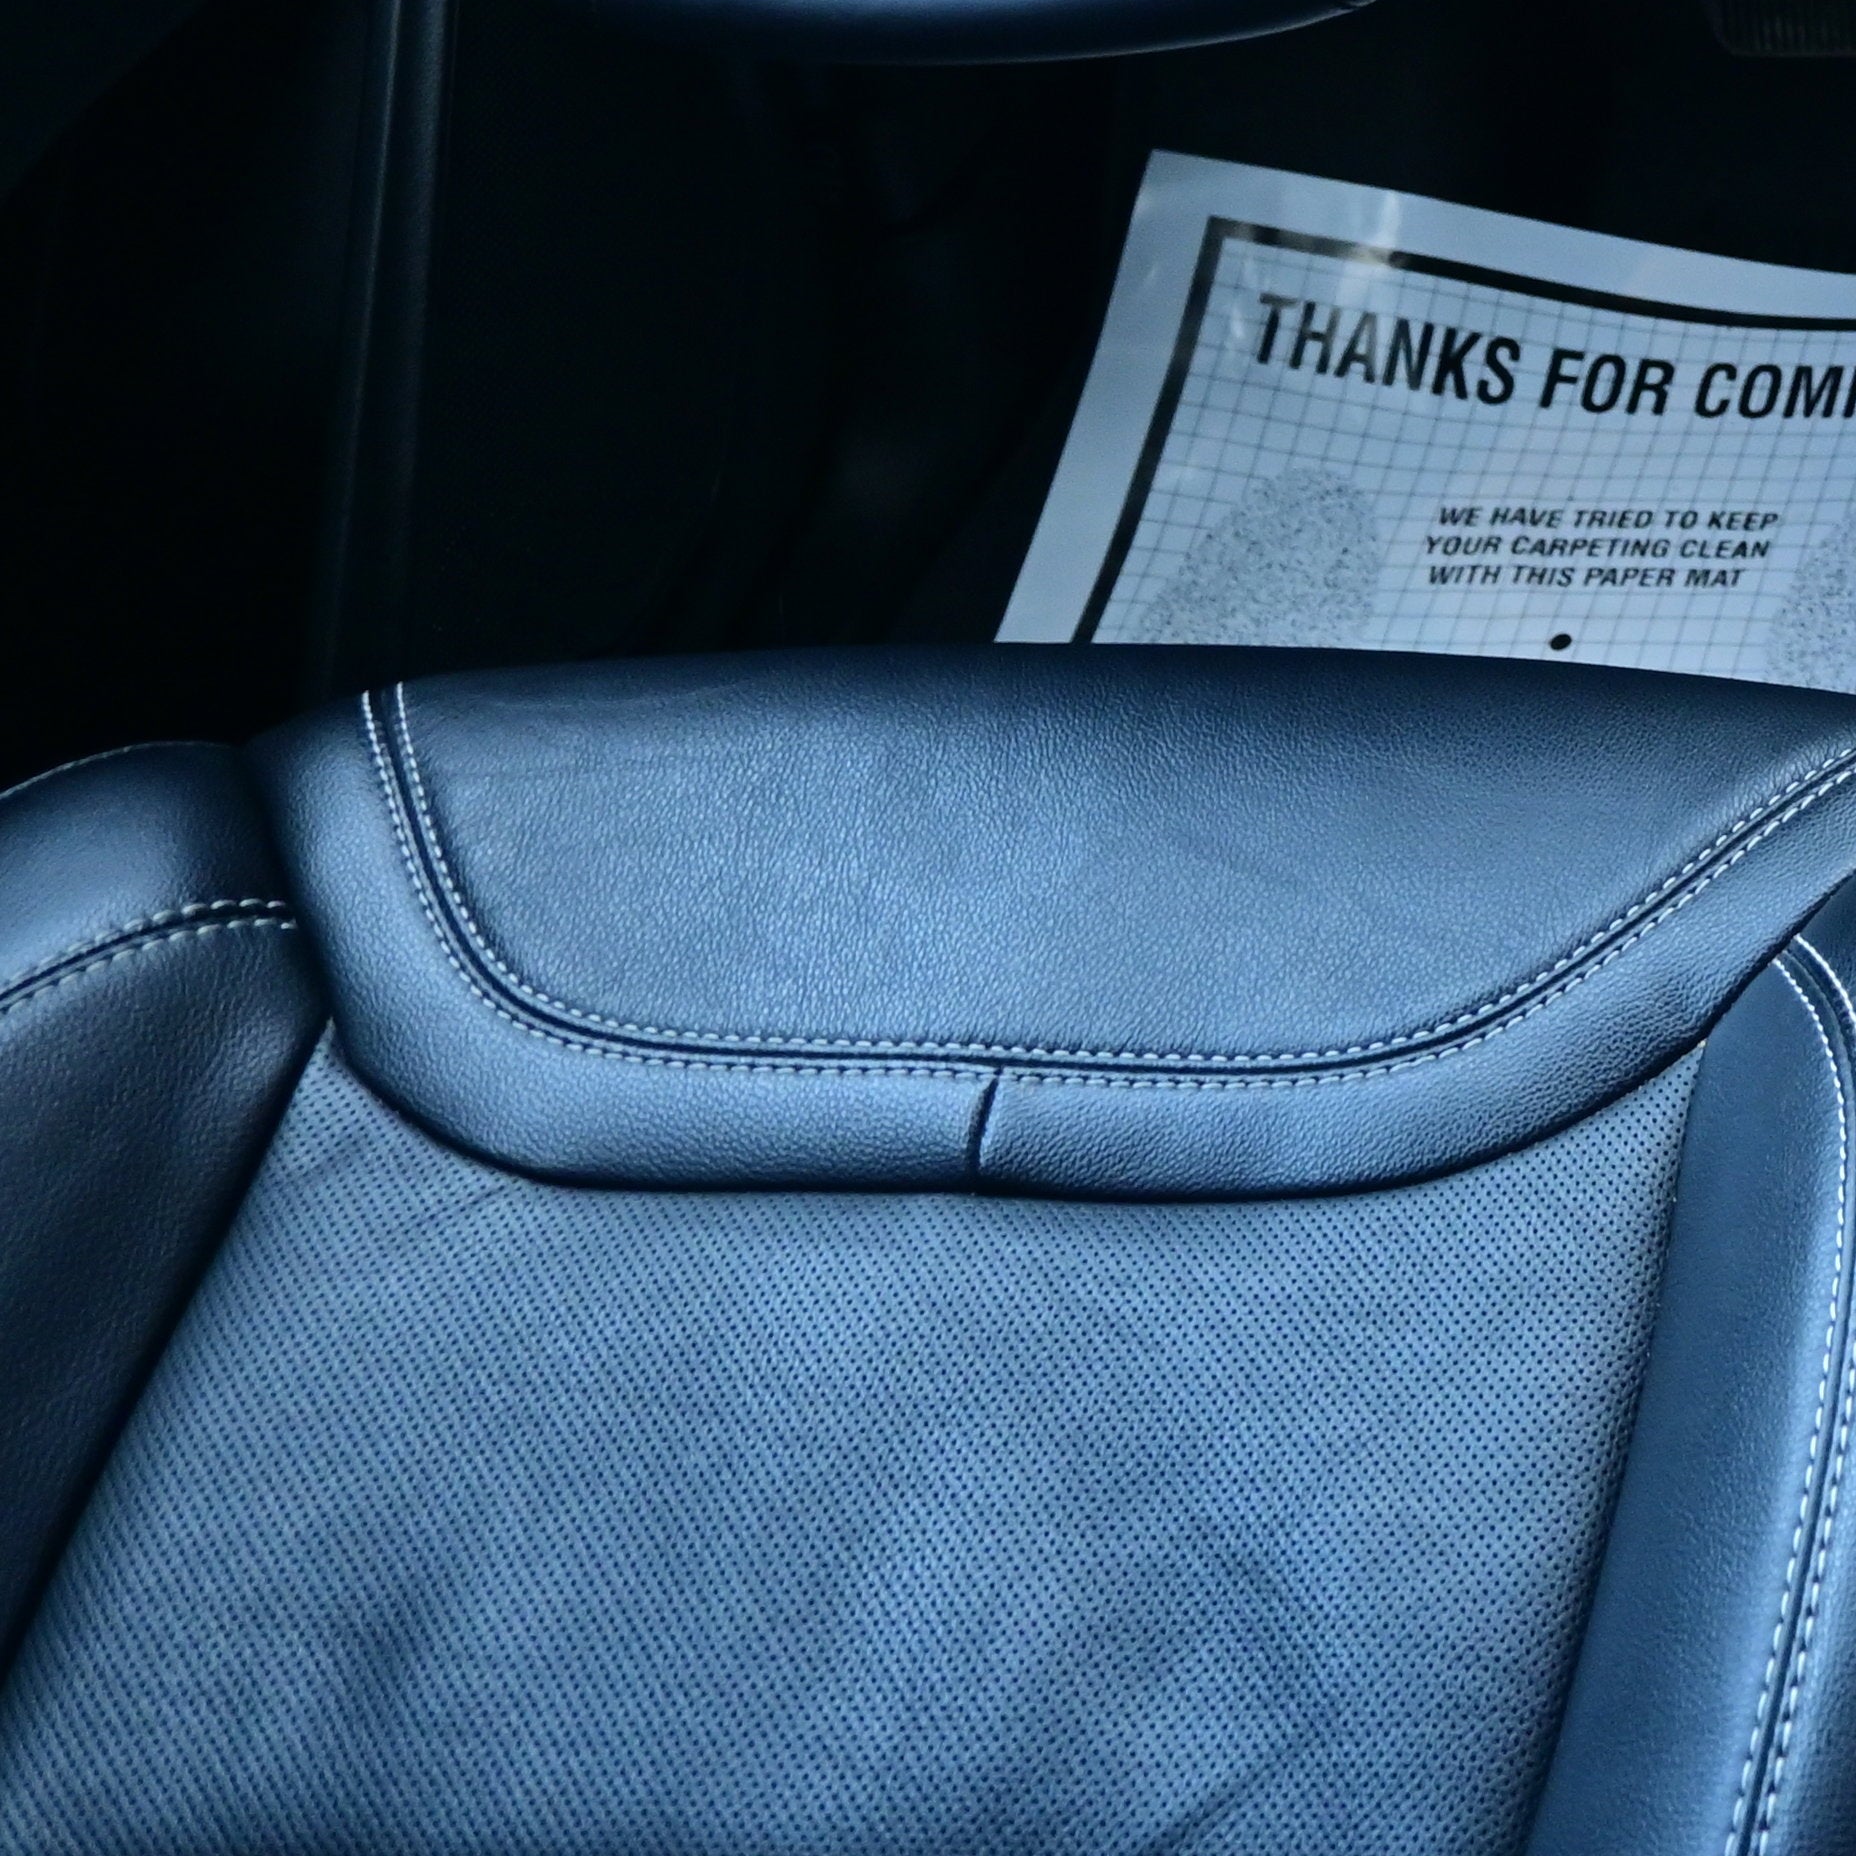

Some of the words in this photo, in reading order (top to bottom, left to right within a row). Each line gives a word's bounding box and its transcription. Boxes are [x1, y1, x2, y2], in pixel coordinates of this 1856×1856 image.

[1256, 292, 1521, 406] THANKS
[1539, 347, 1675, 415] FOR
[1438, 505, 1483, 527] WE
[1489, 506, 1563, 529] HAVE
[1573, 509, 1653, 530] TRIED
[1664, 510, 1699, 530] TO
[1707, 510, 1780, 532] KEEP
[1425, 534, 1503, 556] YOUR
[1509, 535, 1671, 559] CARPETING
[1679, 538, 1773, 560] CLEAN
[1428, 564, 1502, 586] WITH
[1511, 565, 1575, 588] THIS
[1582, 566, 1676, 588] PAPER
[1683, 567, 1746, 589] MAT
